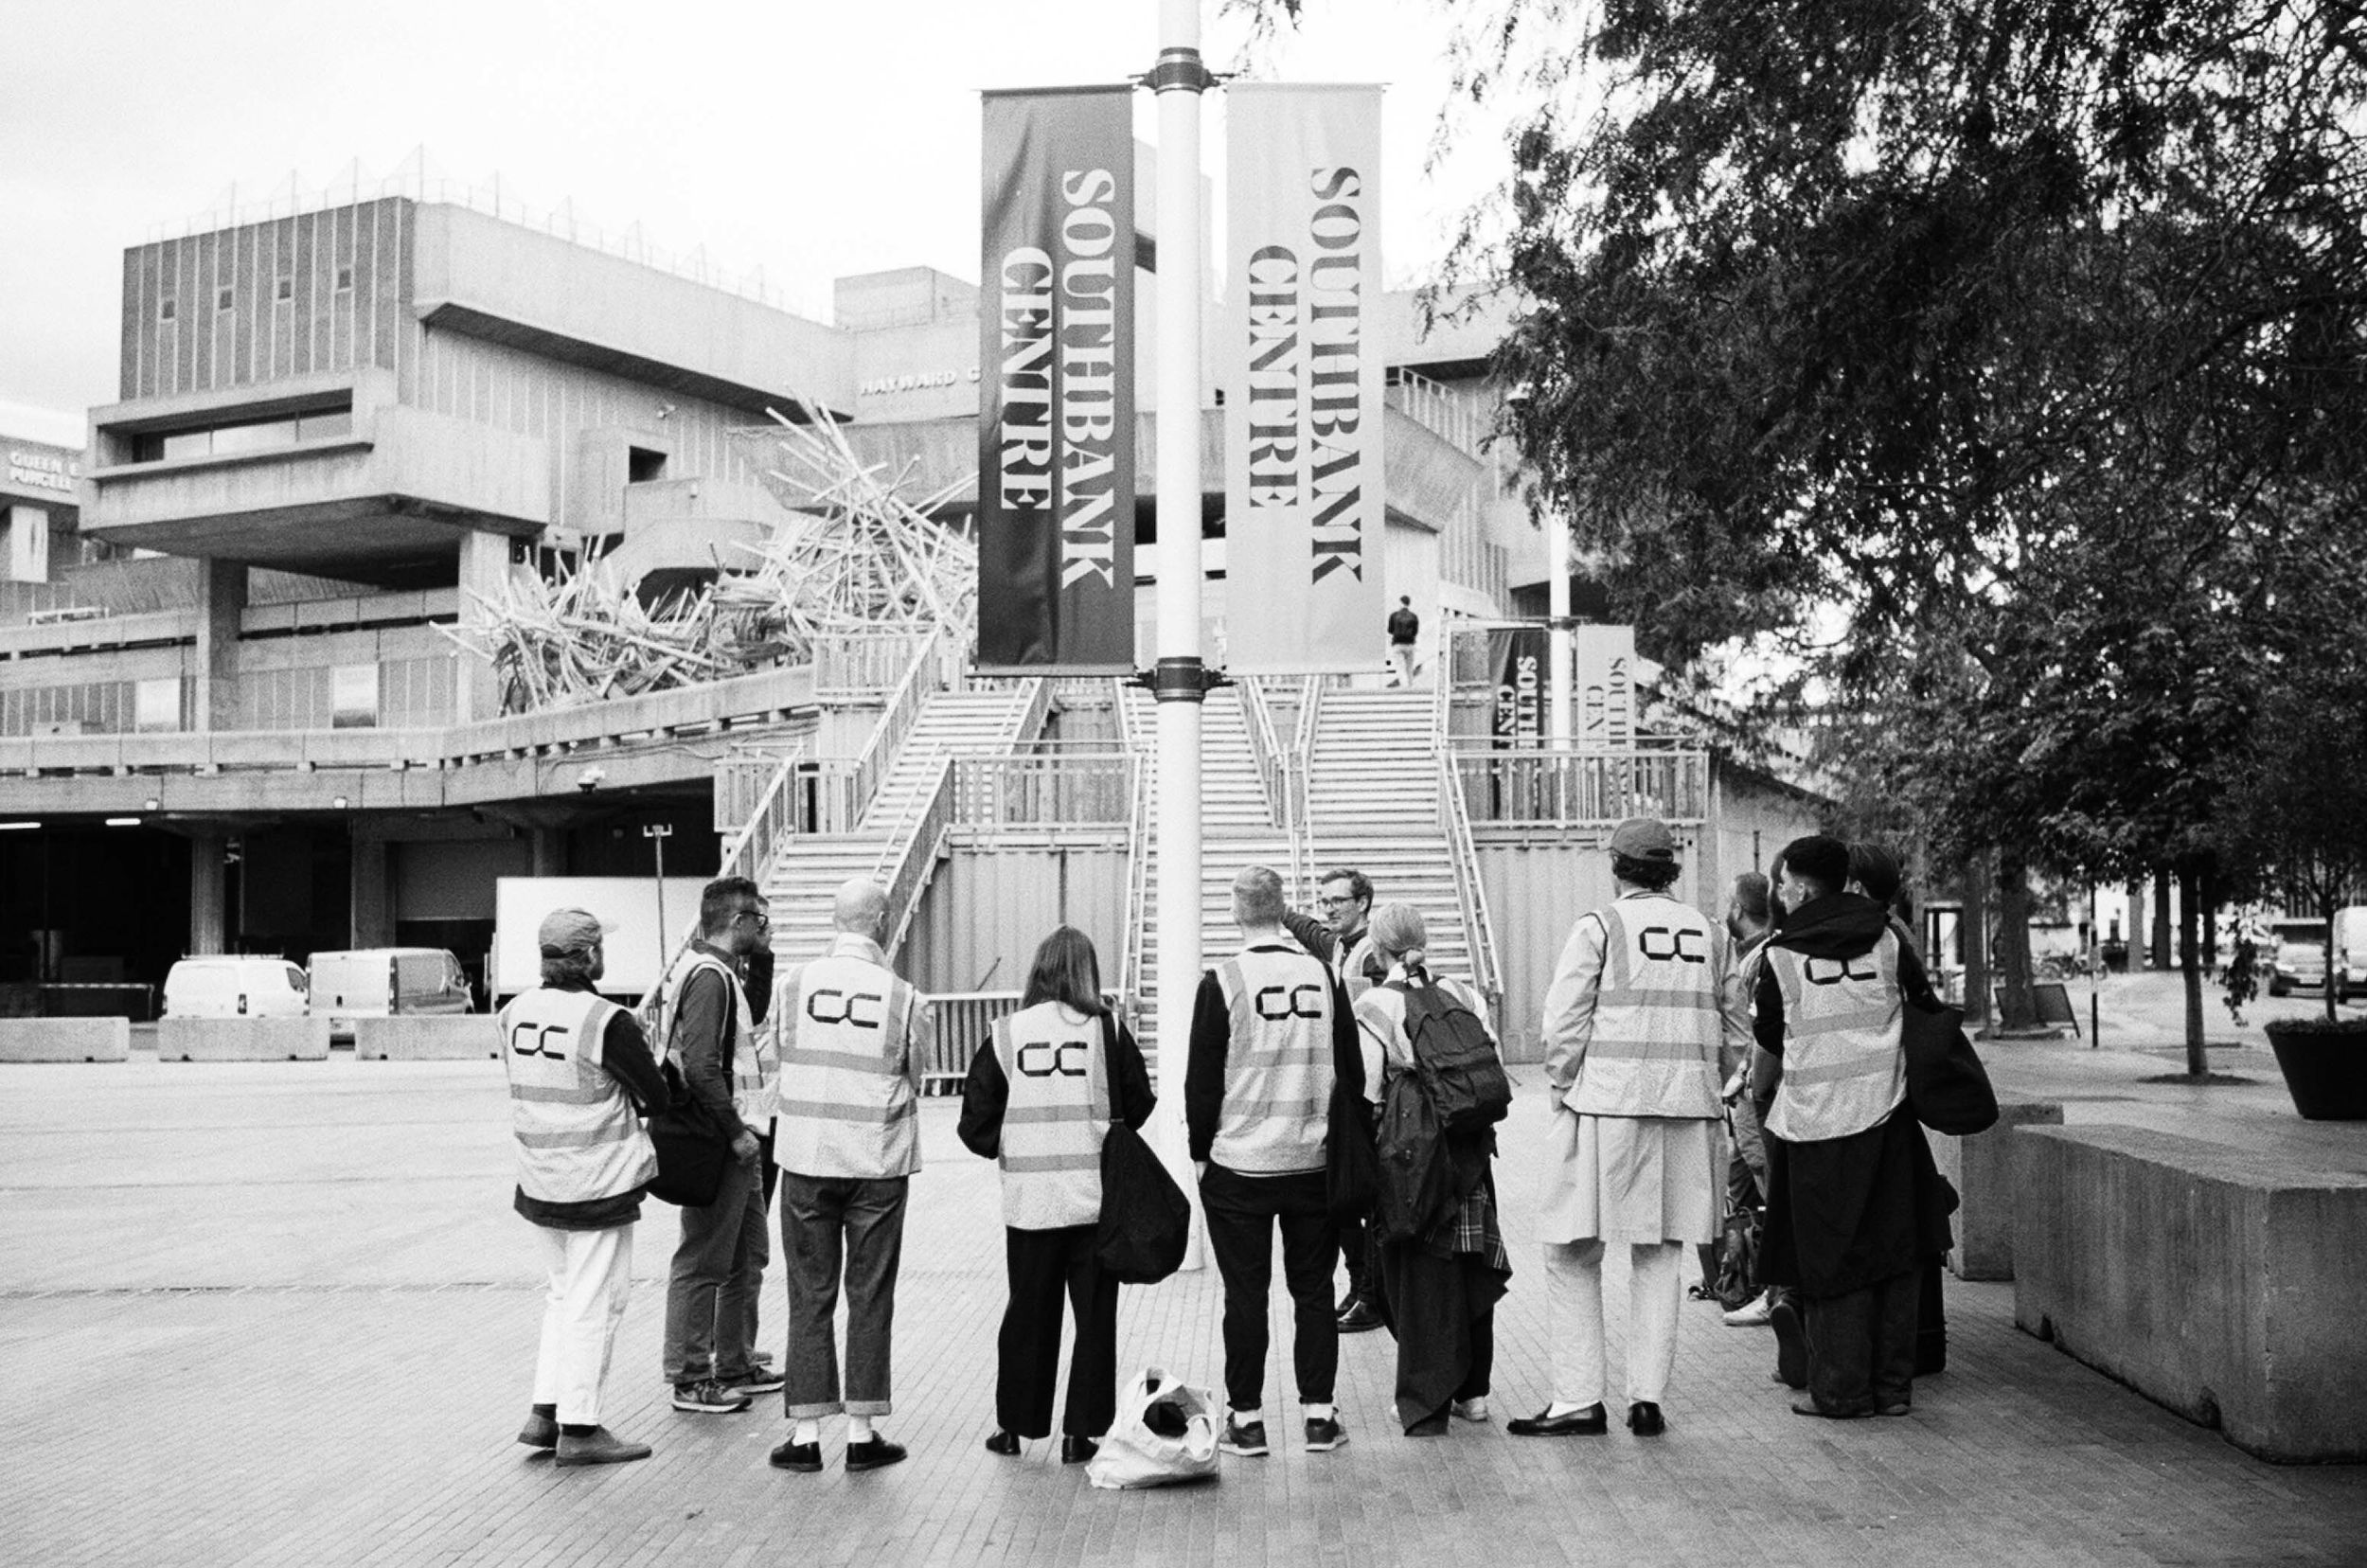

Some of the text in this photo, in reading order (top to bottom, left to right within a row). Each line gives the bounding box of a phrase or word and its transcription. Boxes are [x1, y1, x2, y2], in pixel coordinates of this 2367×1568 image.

[1001, 246, 1053, 509] CENTRE
[1062, 169, 1114, 589] SOUTHBANK
[1249, 245, 1298, 508] CENTRE
[1310, 167, 1361, 585] SOUTHBANK
[1639, 926, 1705, 964] CC
[807, 989, 881, 1029] CC
[1255, 985, 1322, 1022] CC
[512, 1021, 569, 1061] CC
[1017, 1042, 1089, 1078] CC
